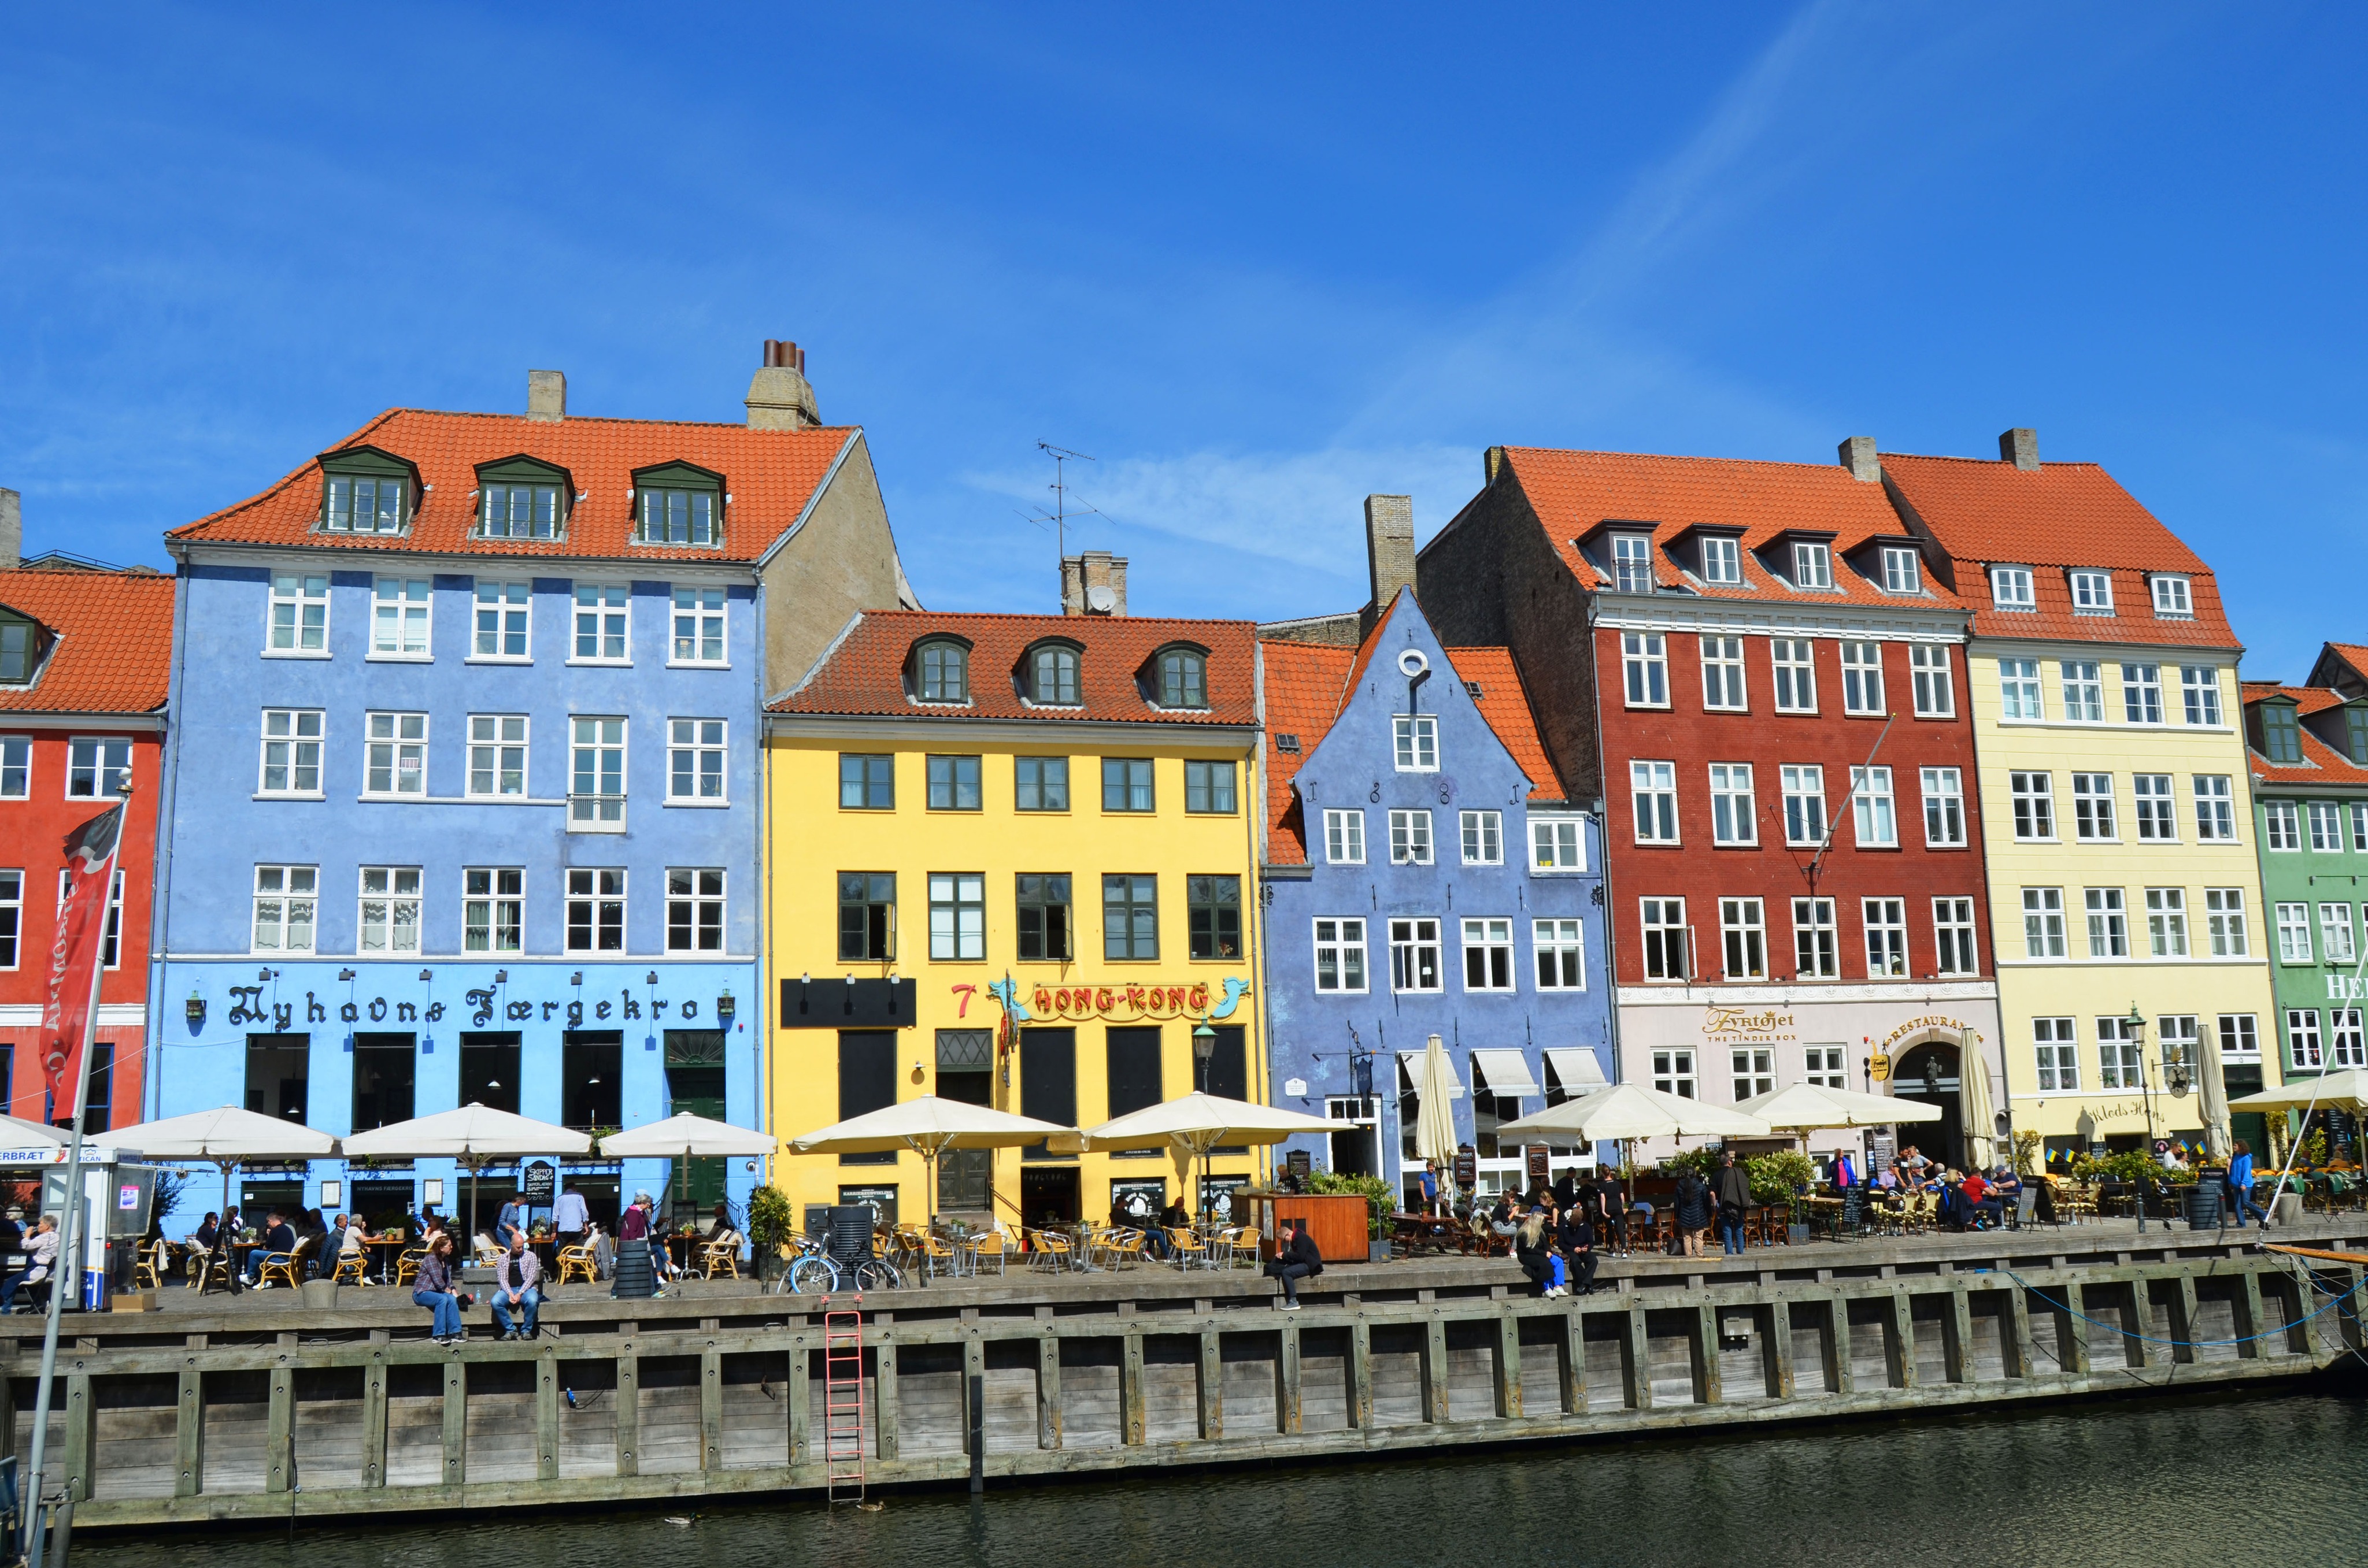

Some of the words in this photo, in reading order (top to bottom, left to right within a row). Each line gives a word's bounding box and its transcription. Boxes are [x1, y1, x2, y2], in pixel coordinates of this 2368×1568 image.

[229, 986, 446, 1031] Nyhavns
[465, 984, 698, 1030] Færgekro
[952, 984, 976, 1018] 7
[1035, 986, 1208, 1015] HONG-KONG
[2089, 1103, 2128, 1125] Klods
